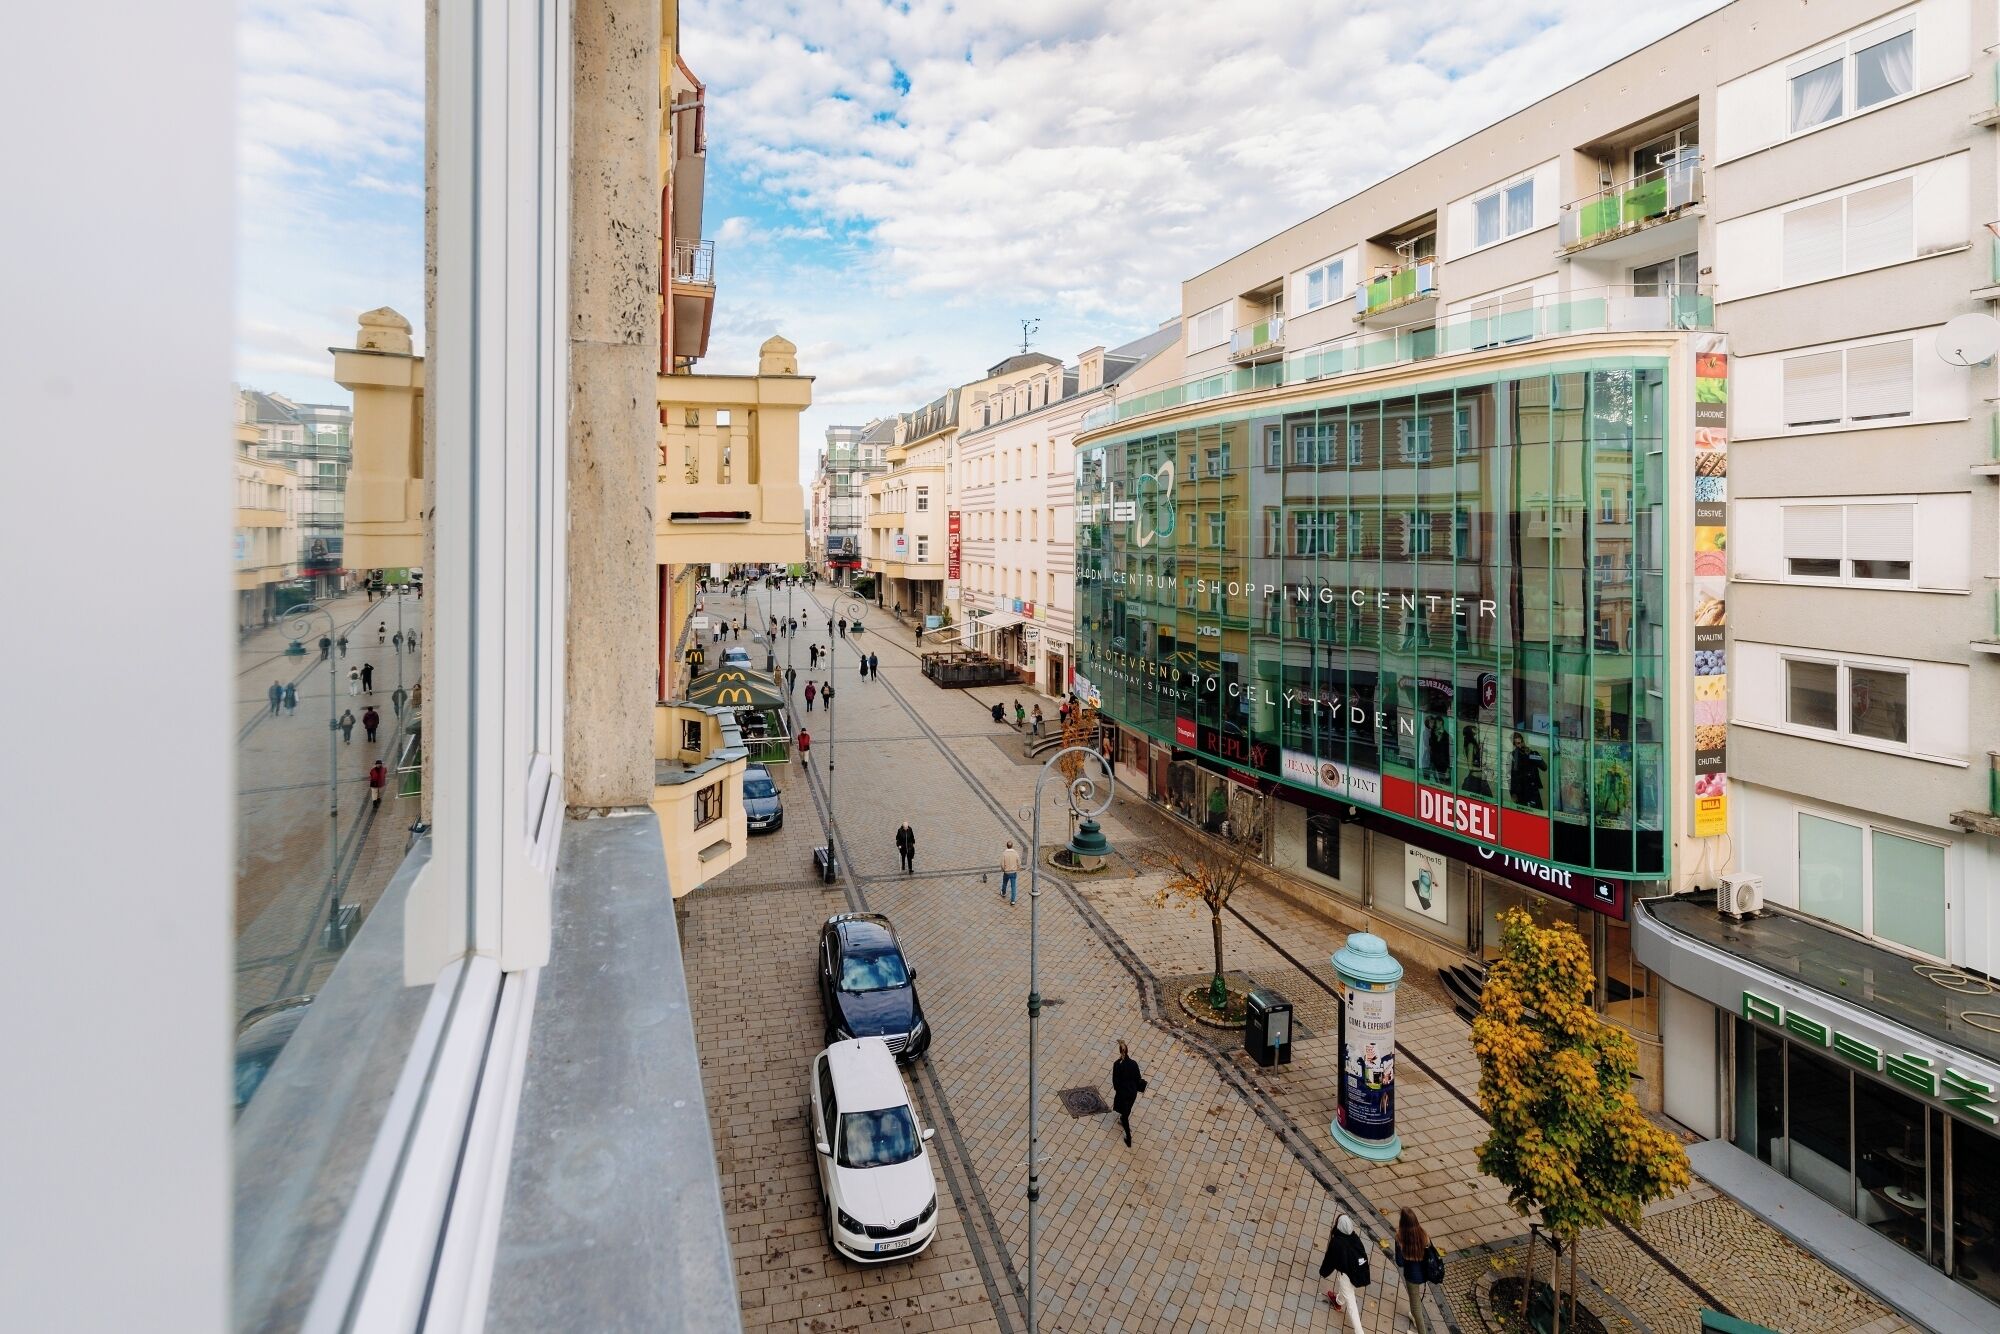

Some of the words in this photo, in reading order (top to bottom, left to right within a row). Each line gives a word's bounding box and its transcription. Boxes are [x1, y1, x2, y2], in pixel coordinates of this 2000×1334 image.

[1113, 571, 1177, 589] CENTRUM
[1197, 580, 1334, 604] SHOPPING
[1351, 589, 1497, 618] CENTER
[1105, 650, 1180, 681] OTEVŘENO
[1191, 674, 1216, 692] PO
[1228, 682, 1295, 709] CELÝ
[1308, 697, 1414, 735] TÝDEN
[1108, 668, 1140, 685] MONDAY
[1147, 681, 1188, 701] SUNDAY
[1208, 731, 1268, 767] REPLAY
[1285, 758, 1319, 778] JEANS
[1340, 772, 1378, 795] POINT
[1420, 788, 1497, 841] DIESEL
[1414, 850, 1435, 863] iPhone
